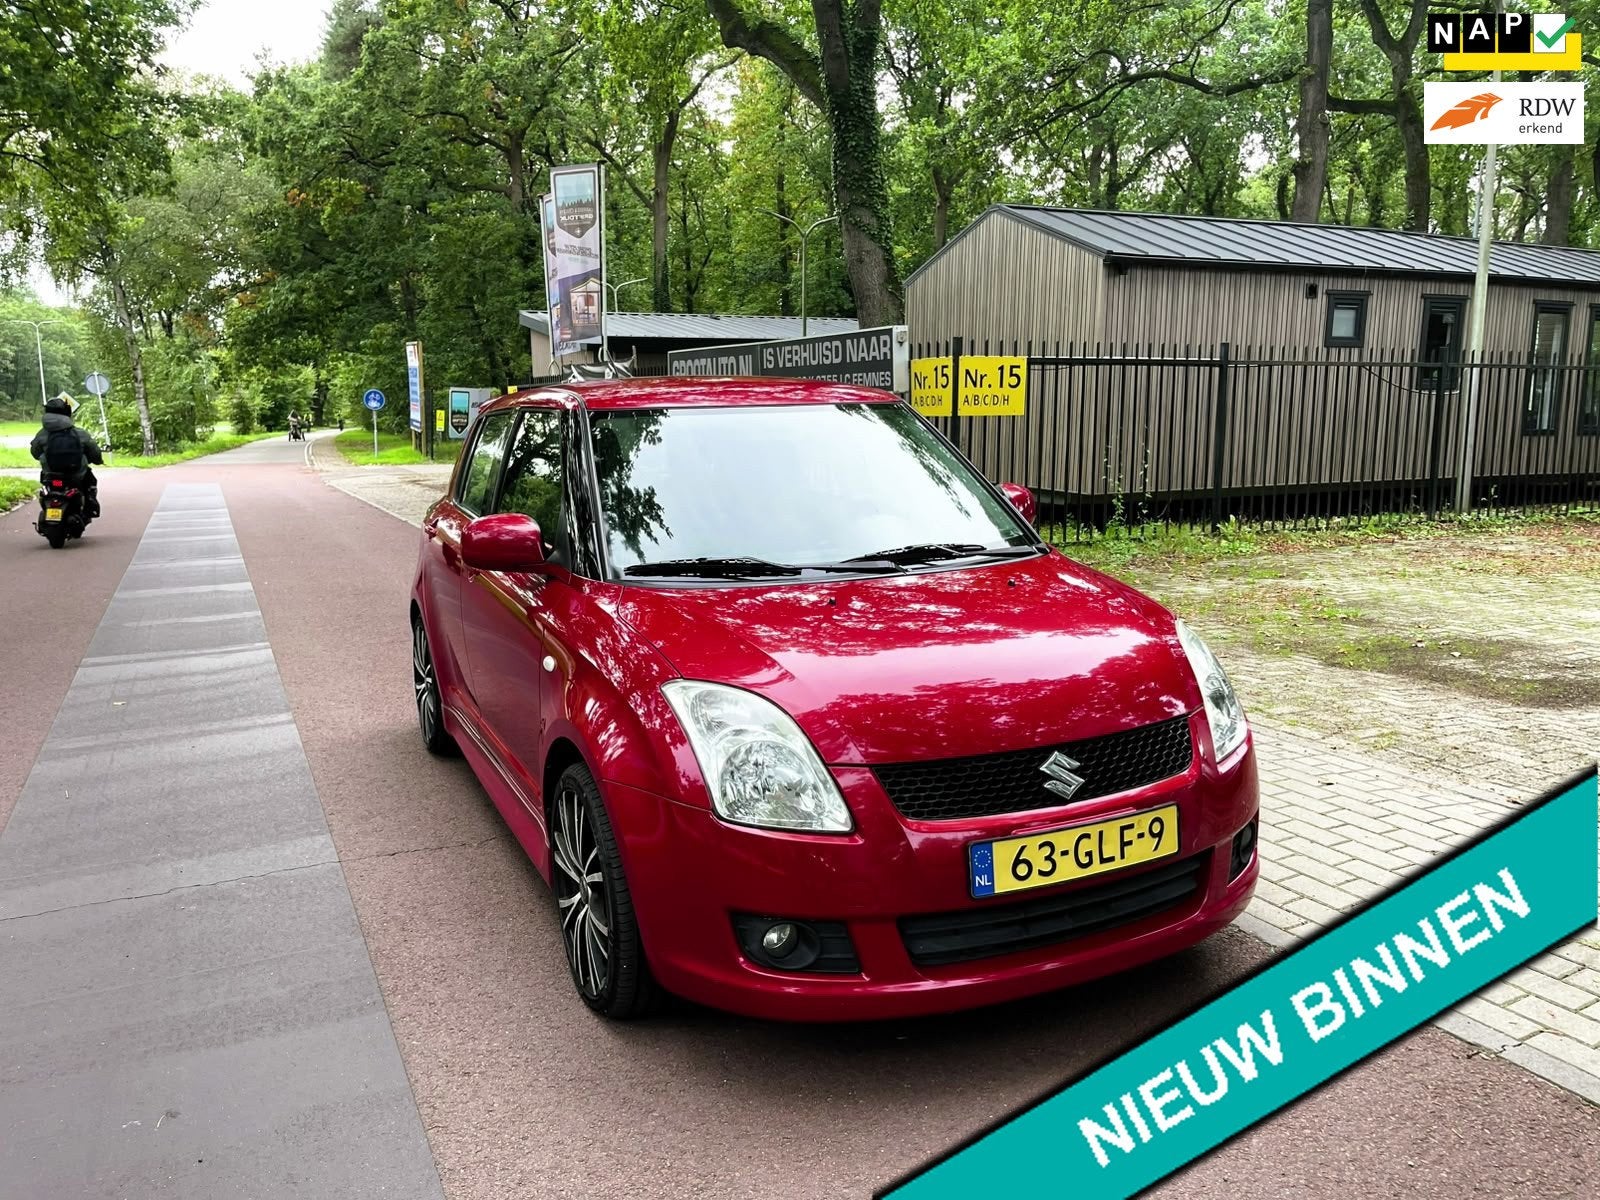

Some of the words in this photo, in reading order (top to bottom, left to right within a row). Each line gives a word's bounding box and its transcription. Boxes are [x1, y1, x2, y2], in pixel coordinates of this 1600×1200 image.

[672, 354, 752, 376] GROOTAUTONL
[763, 347, 774, 369] IS
[776, 340, 842, 369] VERHUISD
[846, 334, 891, 363] NAAR
[914, 371, 931, 390] Nr.
[934, 364, 949, 389] 15
[964, 368, 992, 388] Nr.
[998, 364, 1021, 389] 15
[963, 394, 1009, 406] A/B/C/D/H
[1011, 816, 1165, 882] 63-GLF-9
[975, 874, 992, 887] NL
